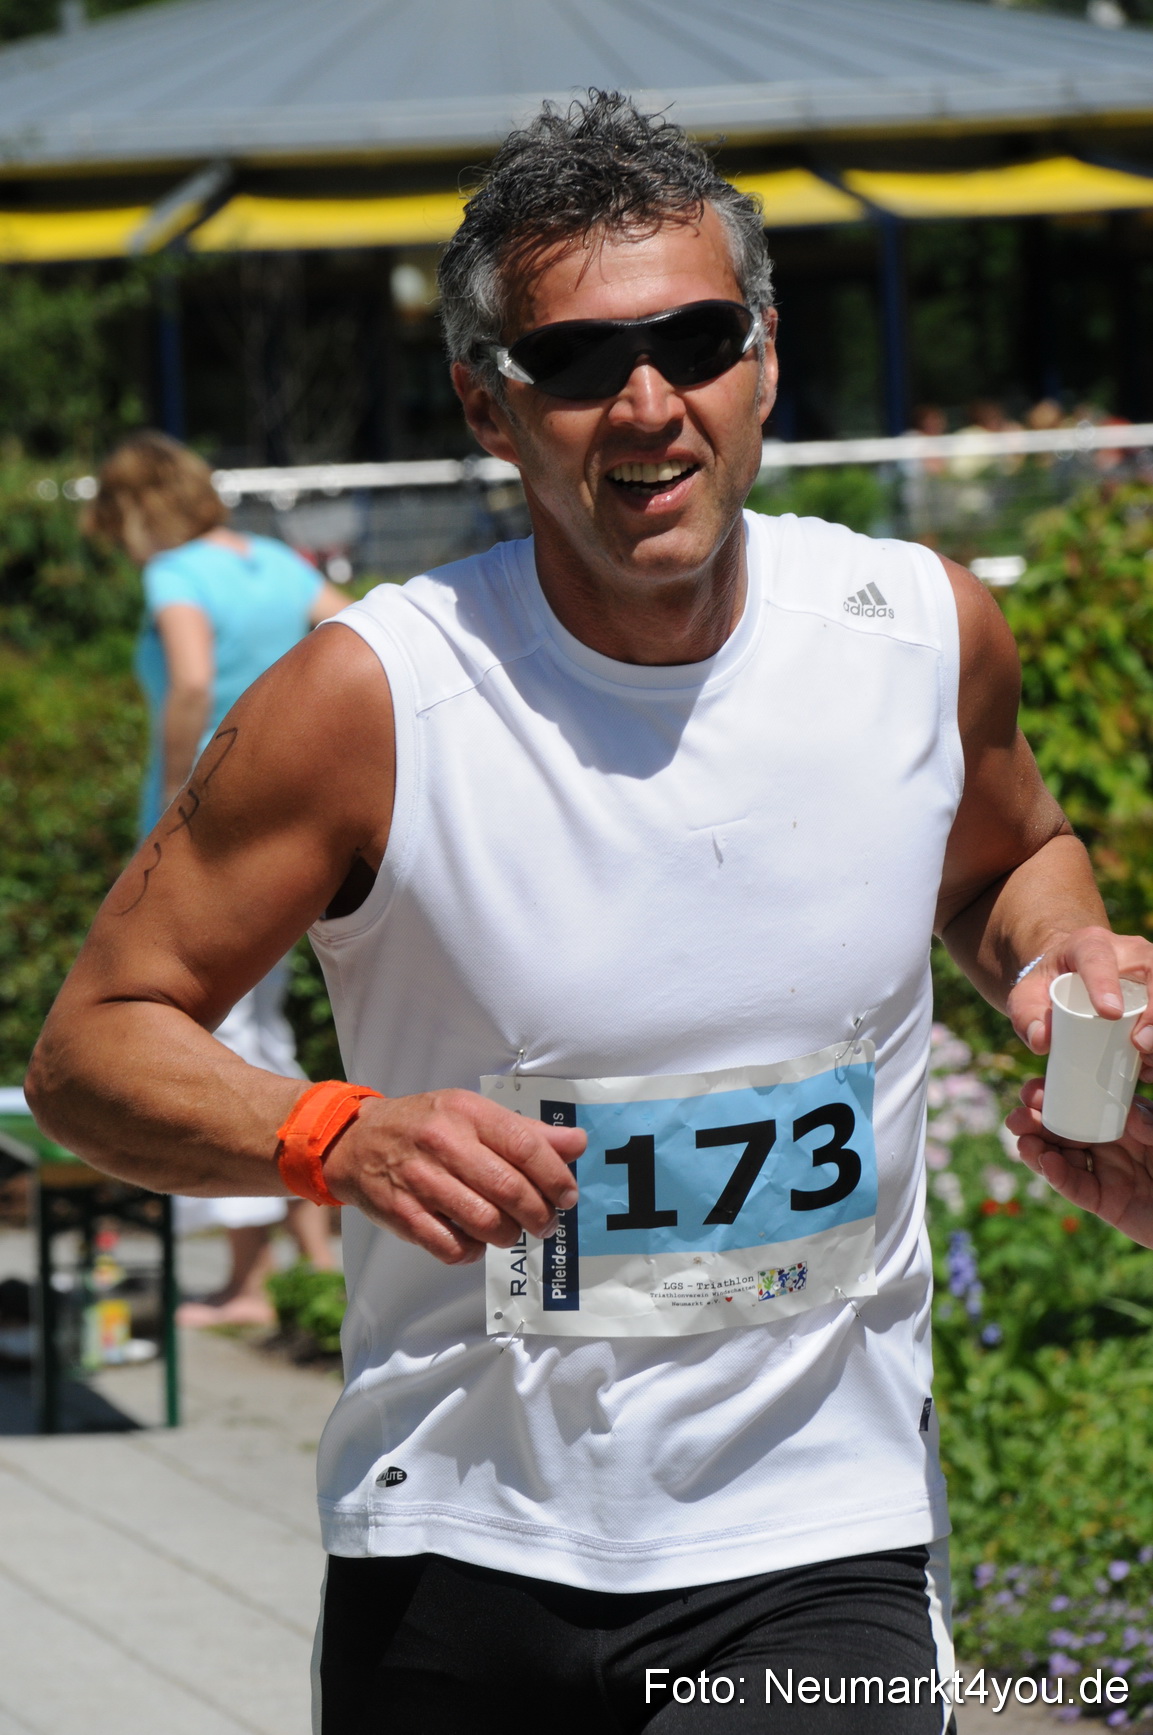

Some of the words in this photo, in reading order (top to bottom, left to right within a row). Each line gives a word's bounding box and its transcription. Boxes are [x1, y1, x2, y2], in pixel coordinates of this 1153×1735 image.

[843, 601, 894, 619] adidas
[604, 1102, 862, 1231] 173
[663, 1282, 684, 1290] LGS
[696, 1276, 754, 1290] Triathlon
[712, 1284, 756, 1297] Windschatten
